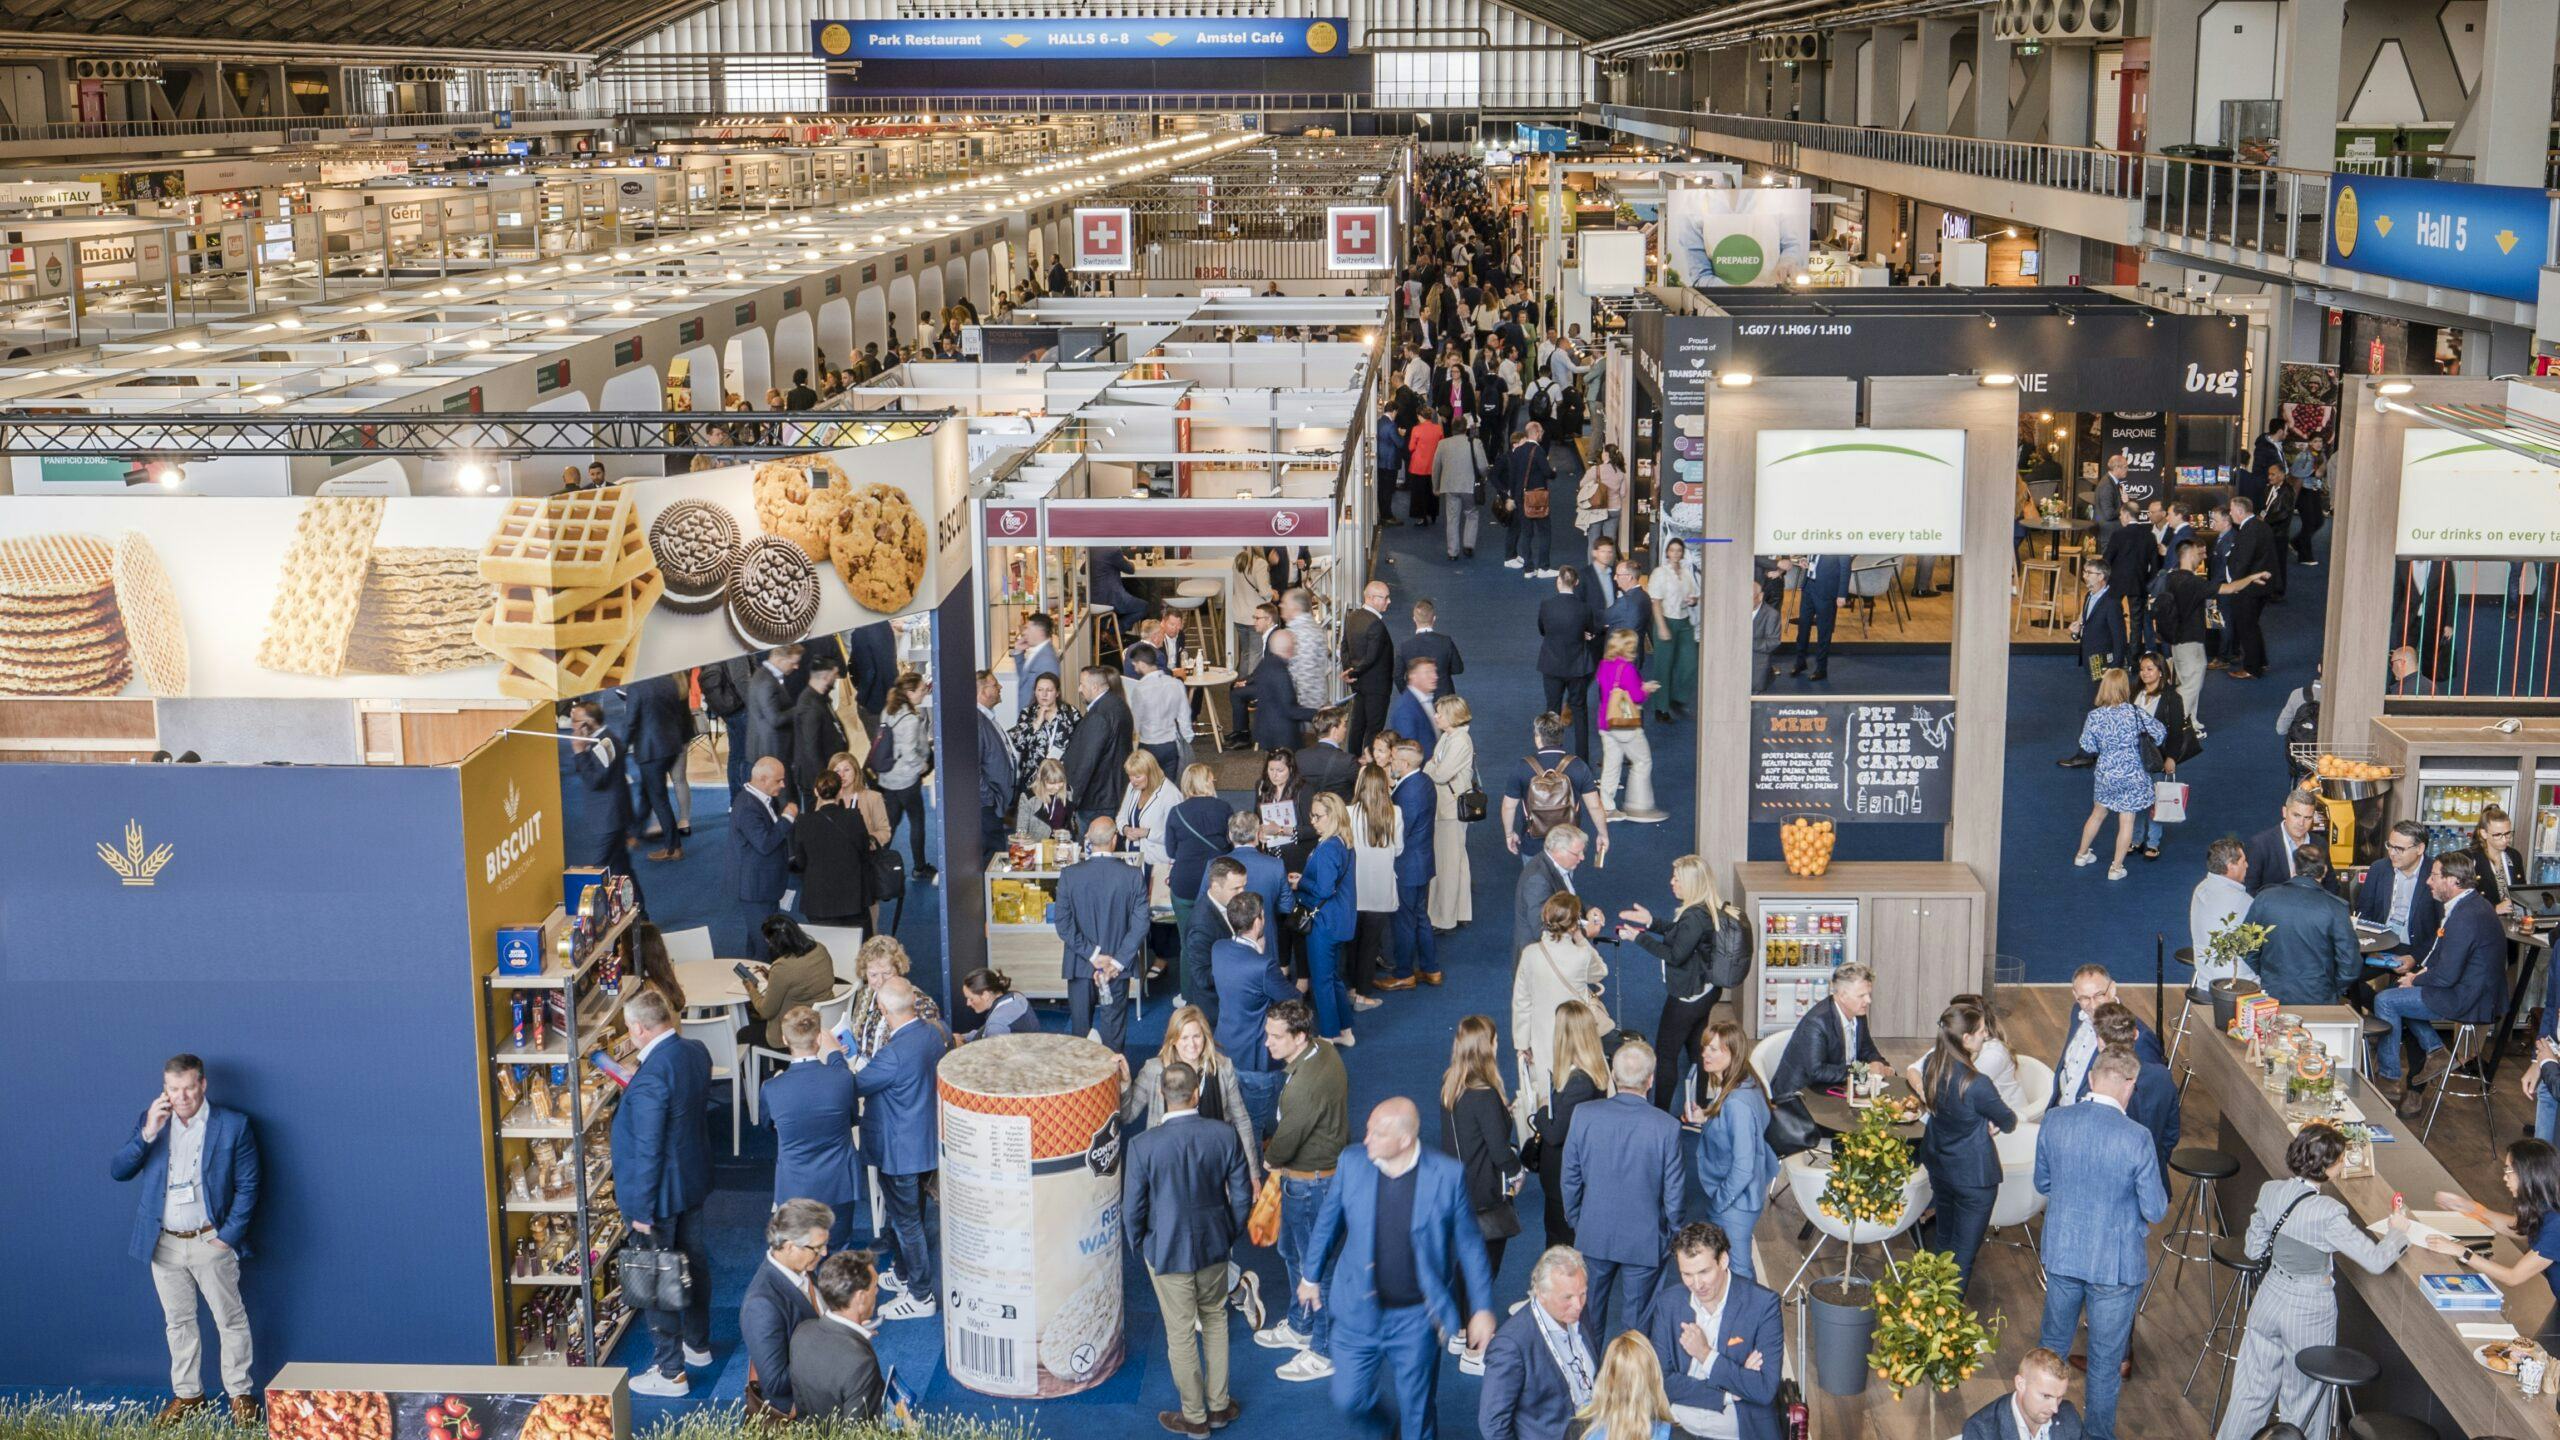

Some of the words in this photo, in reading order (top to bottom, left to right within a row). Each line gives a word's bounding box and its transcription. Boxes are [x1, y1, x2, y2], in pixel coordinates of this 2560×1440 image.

[869, 34, 901, 46] Park
[905, 34, 982, 46] Restaurant
[1048, 33, 1096, 45] HALLS
[1196, 32, 1247, 44] Amstel
[1251, 31, 1284, 44] Café
[19, 195, 45, 204] MADE
[46, 195, 56, 203] IN
[57, 191, 91, 202] ITALY
[2416, 211, 2451, 249] Hall
[2455, 216, 2468, 251] 5
[1083, 257, 1123, 265] Switzerland.
[1716, 256, 1760, 265] PREPARED
[1229, 267, 1265, 280] Group
[1738, 324, 1771, 336] 1.G07
[1779, 324, 1811, 336] 1.H06
[1819, 324, 1852, 336] 1.H10
[2184, 362, 2240, 398] big
[2112, 428, 2157, 439] BARONIE
[44, 456, 83, 465] PANIFICIO
[2121, 446, 2156, 470] big
[938, 495, 969, 553] BISCUIT
[1773, 529, 1797, 541] Our
[1801, 528, 1842, 541] drinks
[1847, 530, 1864, 541] on
[1868, 530, 1906, 543] every
[1909, 528, 1943, 541] table
[2411, 528, 2436, 541] Our
[2440, 528, 2482, 542] drinks
[2487, 530, 2503, 541] on
[2508, 530, 2546, 544] every
[1858, 706, 1897, 722] PET
[1770, 717, 1829, 732] MENU
[1857, 722, 1911, 738] APET
[1857, 738, 1912, 754] CANS
[1856, 755, 1940, 770] CARTON
[1856, 771, 1920, 786] GLASS
[485, 809, 543, 884] BISCUIT
[495, 854, 537, 894] INTERNATIONAL
